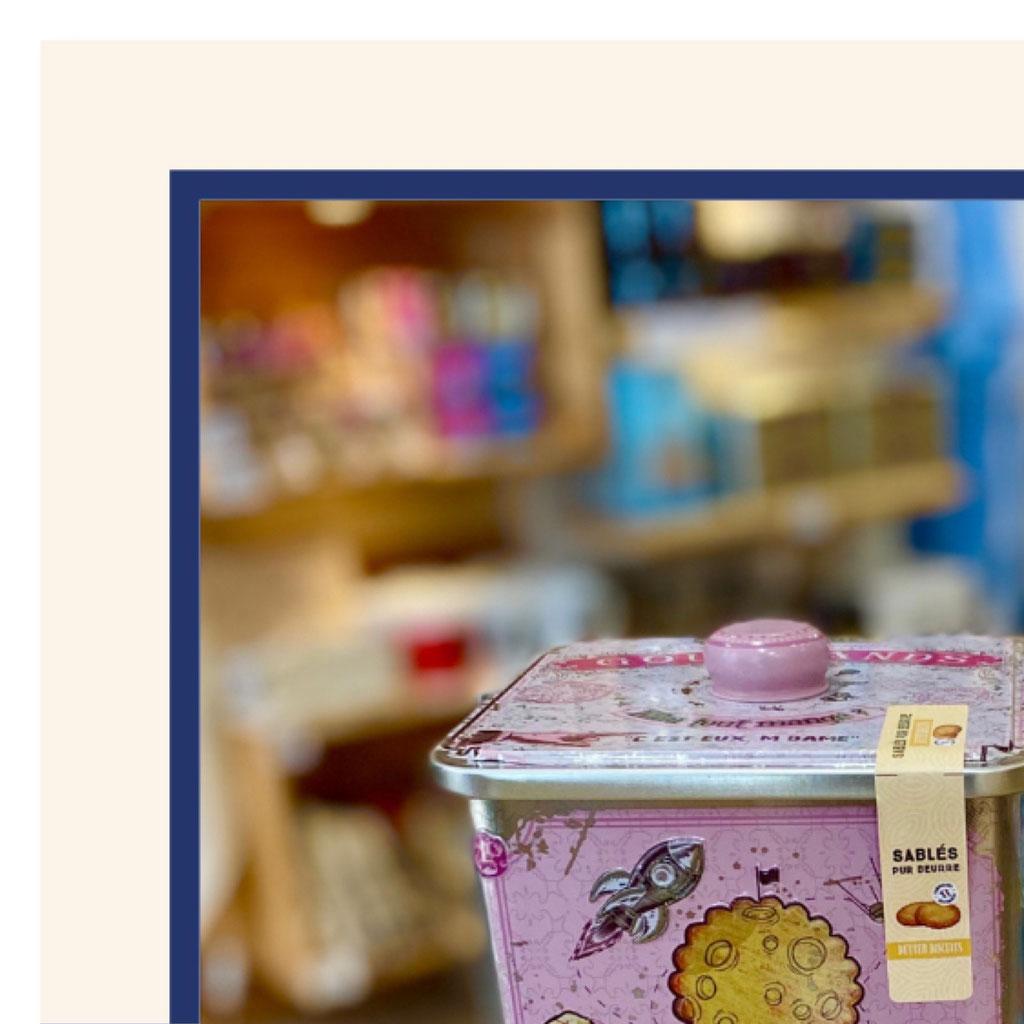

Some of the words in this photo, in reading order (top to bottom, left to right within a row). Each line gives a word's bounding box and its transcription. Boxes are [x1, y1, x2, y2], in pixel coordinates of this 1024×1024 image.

[892, 843, 958, 862] SABLÉS
[892, 866, 913, 876] PUR
[918, 863, 960, 874] BEURRE
